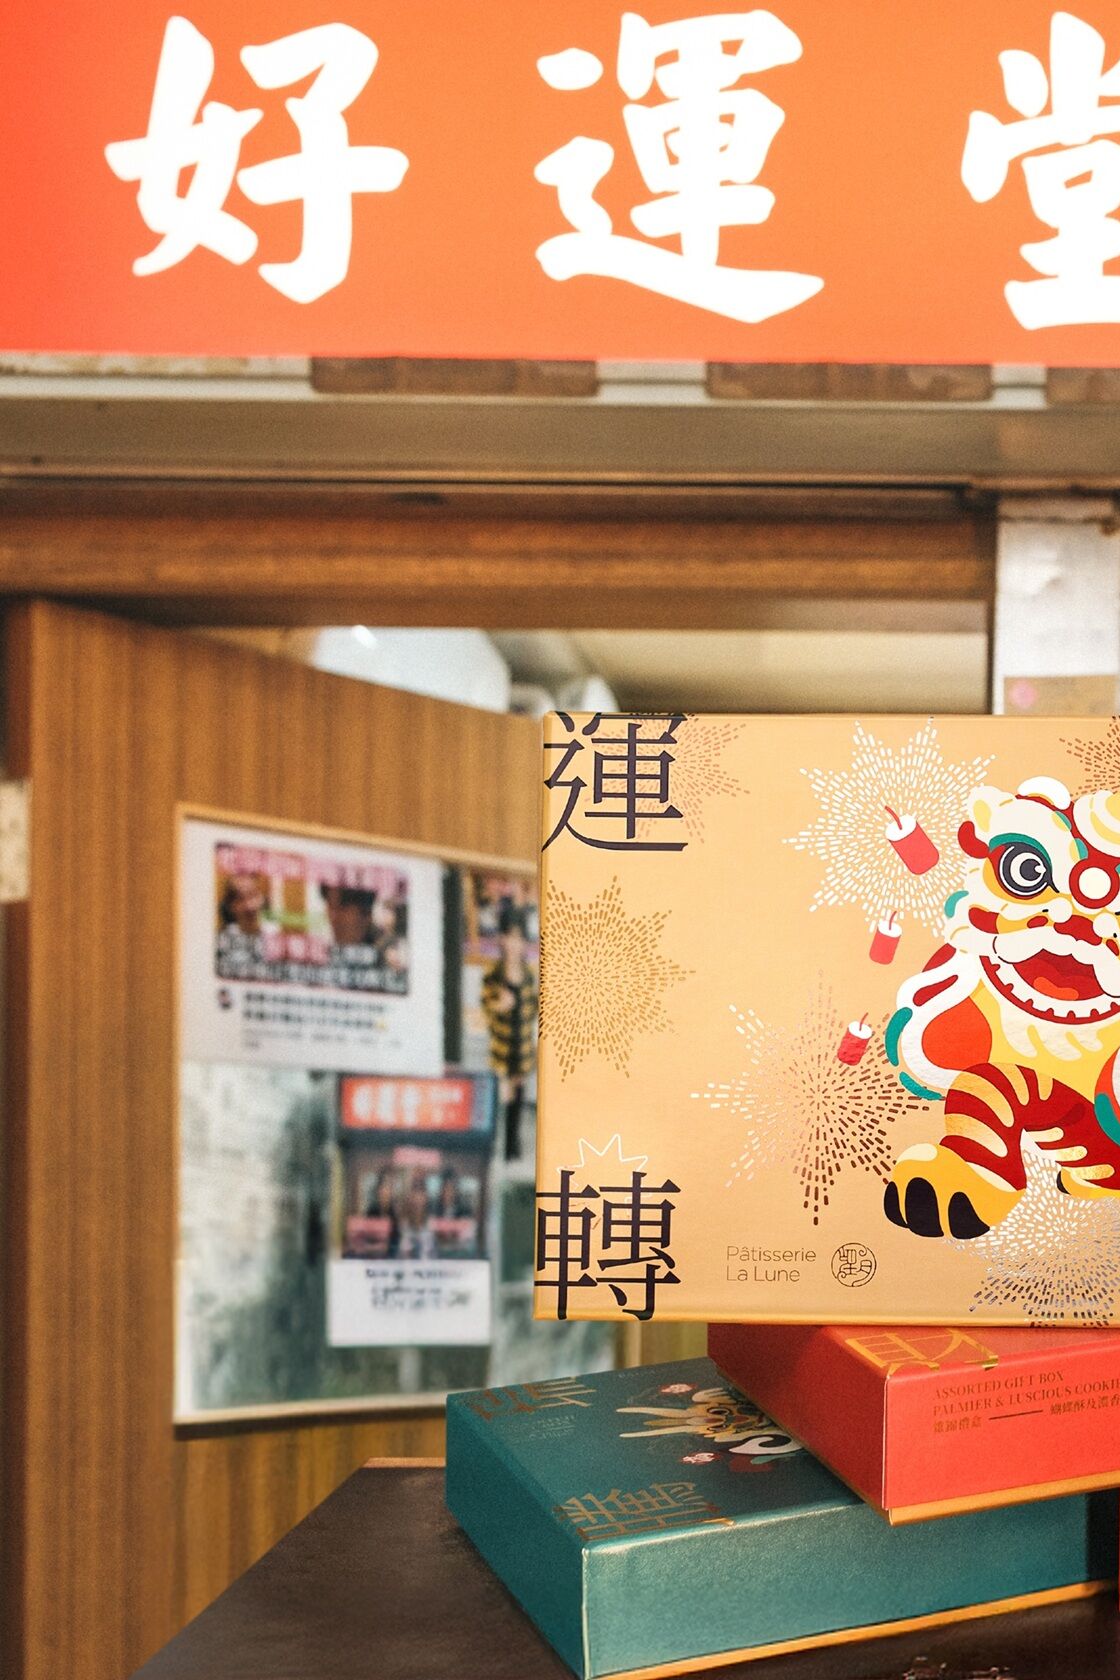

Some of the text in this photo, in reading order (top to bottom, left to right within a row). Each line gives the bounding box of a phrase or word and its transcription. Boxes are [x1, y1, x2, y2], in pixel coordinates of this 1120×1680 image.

[541, 711, 689, 852] 運
[534, 1170, 681, 1320] 轉
[727, 1245, 817, 1262] Pâtisserie
[726, 1265, 800, 1282] La Lune
[935, 1370, 1064, 1399] ASSORTED GIFT BOX
[933, 1398, 992, 1416] PALMIER
[1009, 1386, 1072, 1405] LUSCIOUS
